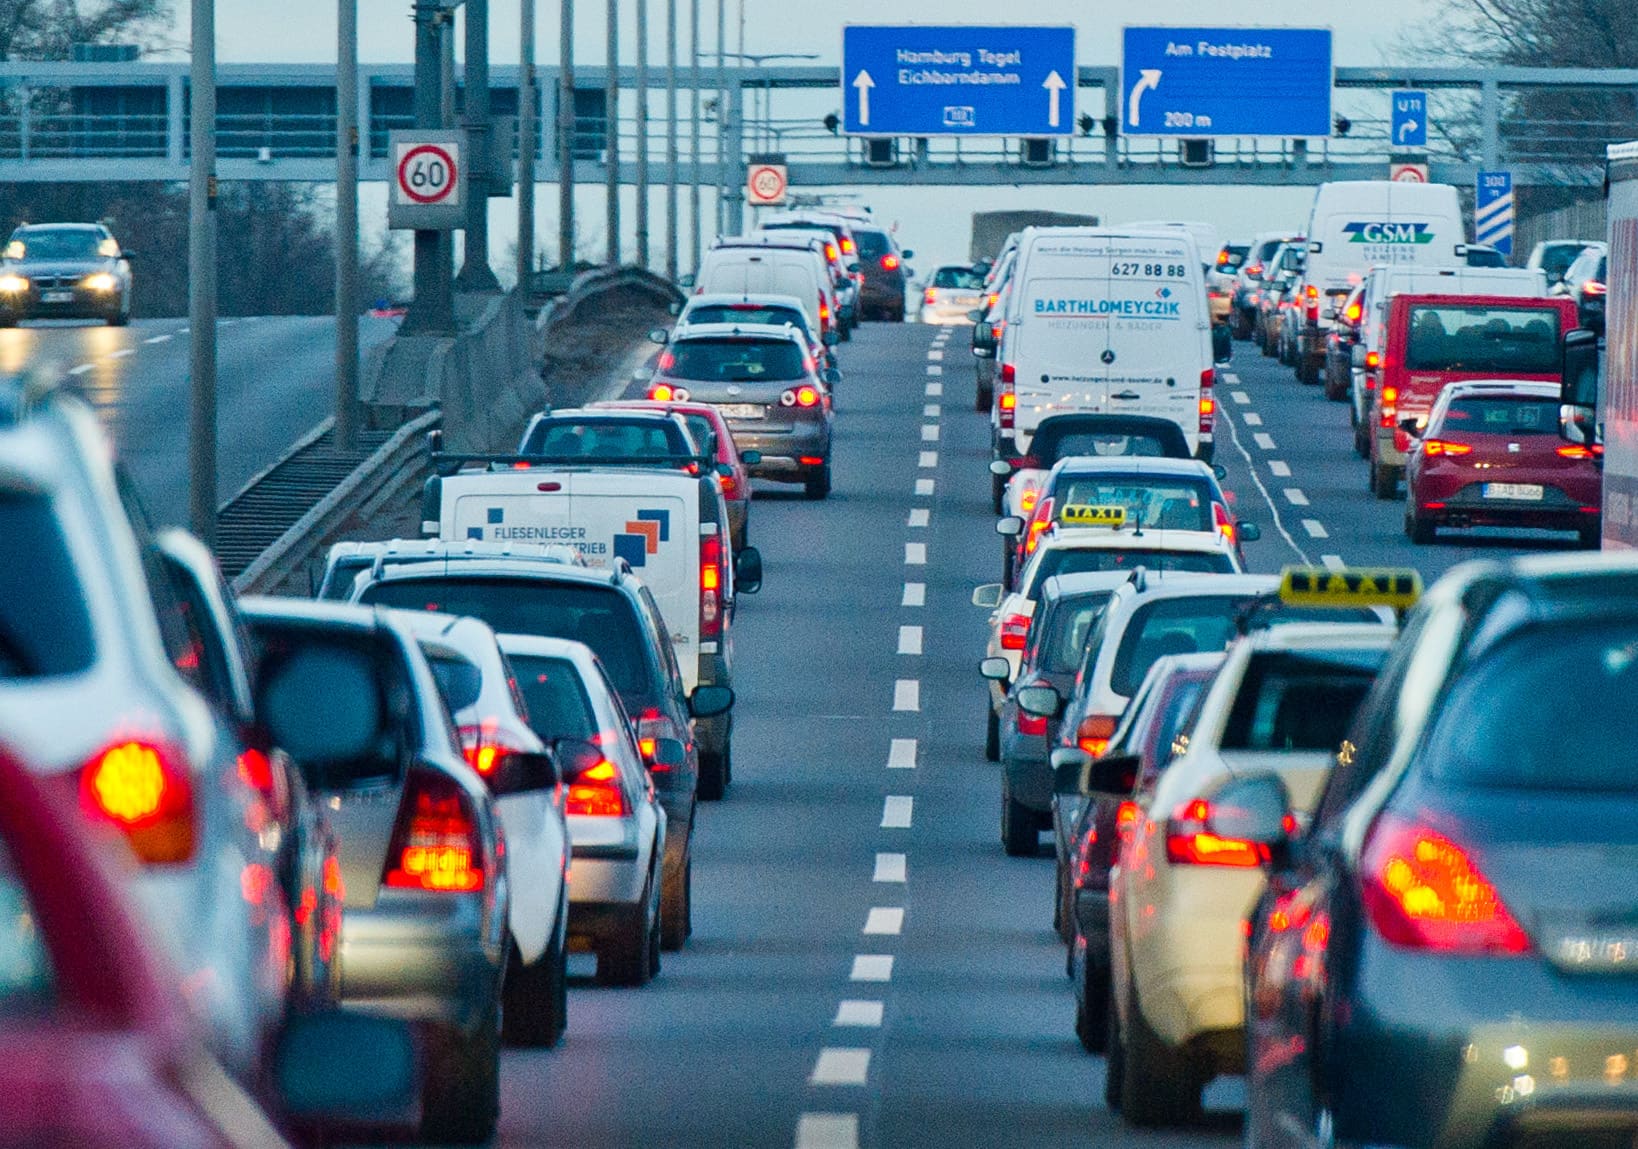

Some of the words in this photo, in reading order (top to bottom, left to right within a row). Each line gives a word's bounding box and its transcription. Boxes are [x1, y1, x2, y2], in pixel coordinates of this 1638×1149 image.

[896, 48, 971, 67] Hamburg
[977, 48, 1021, 67] Tegel
[1165, 41, 1193, 56] Am
[1197, 41, 1272, 60] Festplatz
[1164, 111, 1194, 128] 200
[1195, 115, 1212, 128] m
[412, 160, 444, 187] 60
[1484, 175, 1505, 187] 300
[759, 174, 777, 191] 60
[1363, 223, 1416, 242] GSM
[1111, 262, 1140, 276] 627
[1144, 263, 1162, 277] 88
[1167, 264, 1185, 278] 88
[1034, 299, 1180, 315] BARTHLOMEYCZIK
[1069, 507, 1117, 518] TAXI
[495, 527, 586, 539] FLIESENLEGER
[1302, 571, 1400, 594] TAXI
